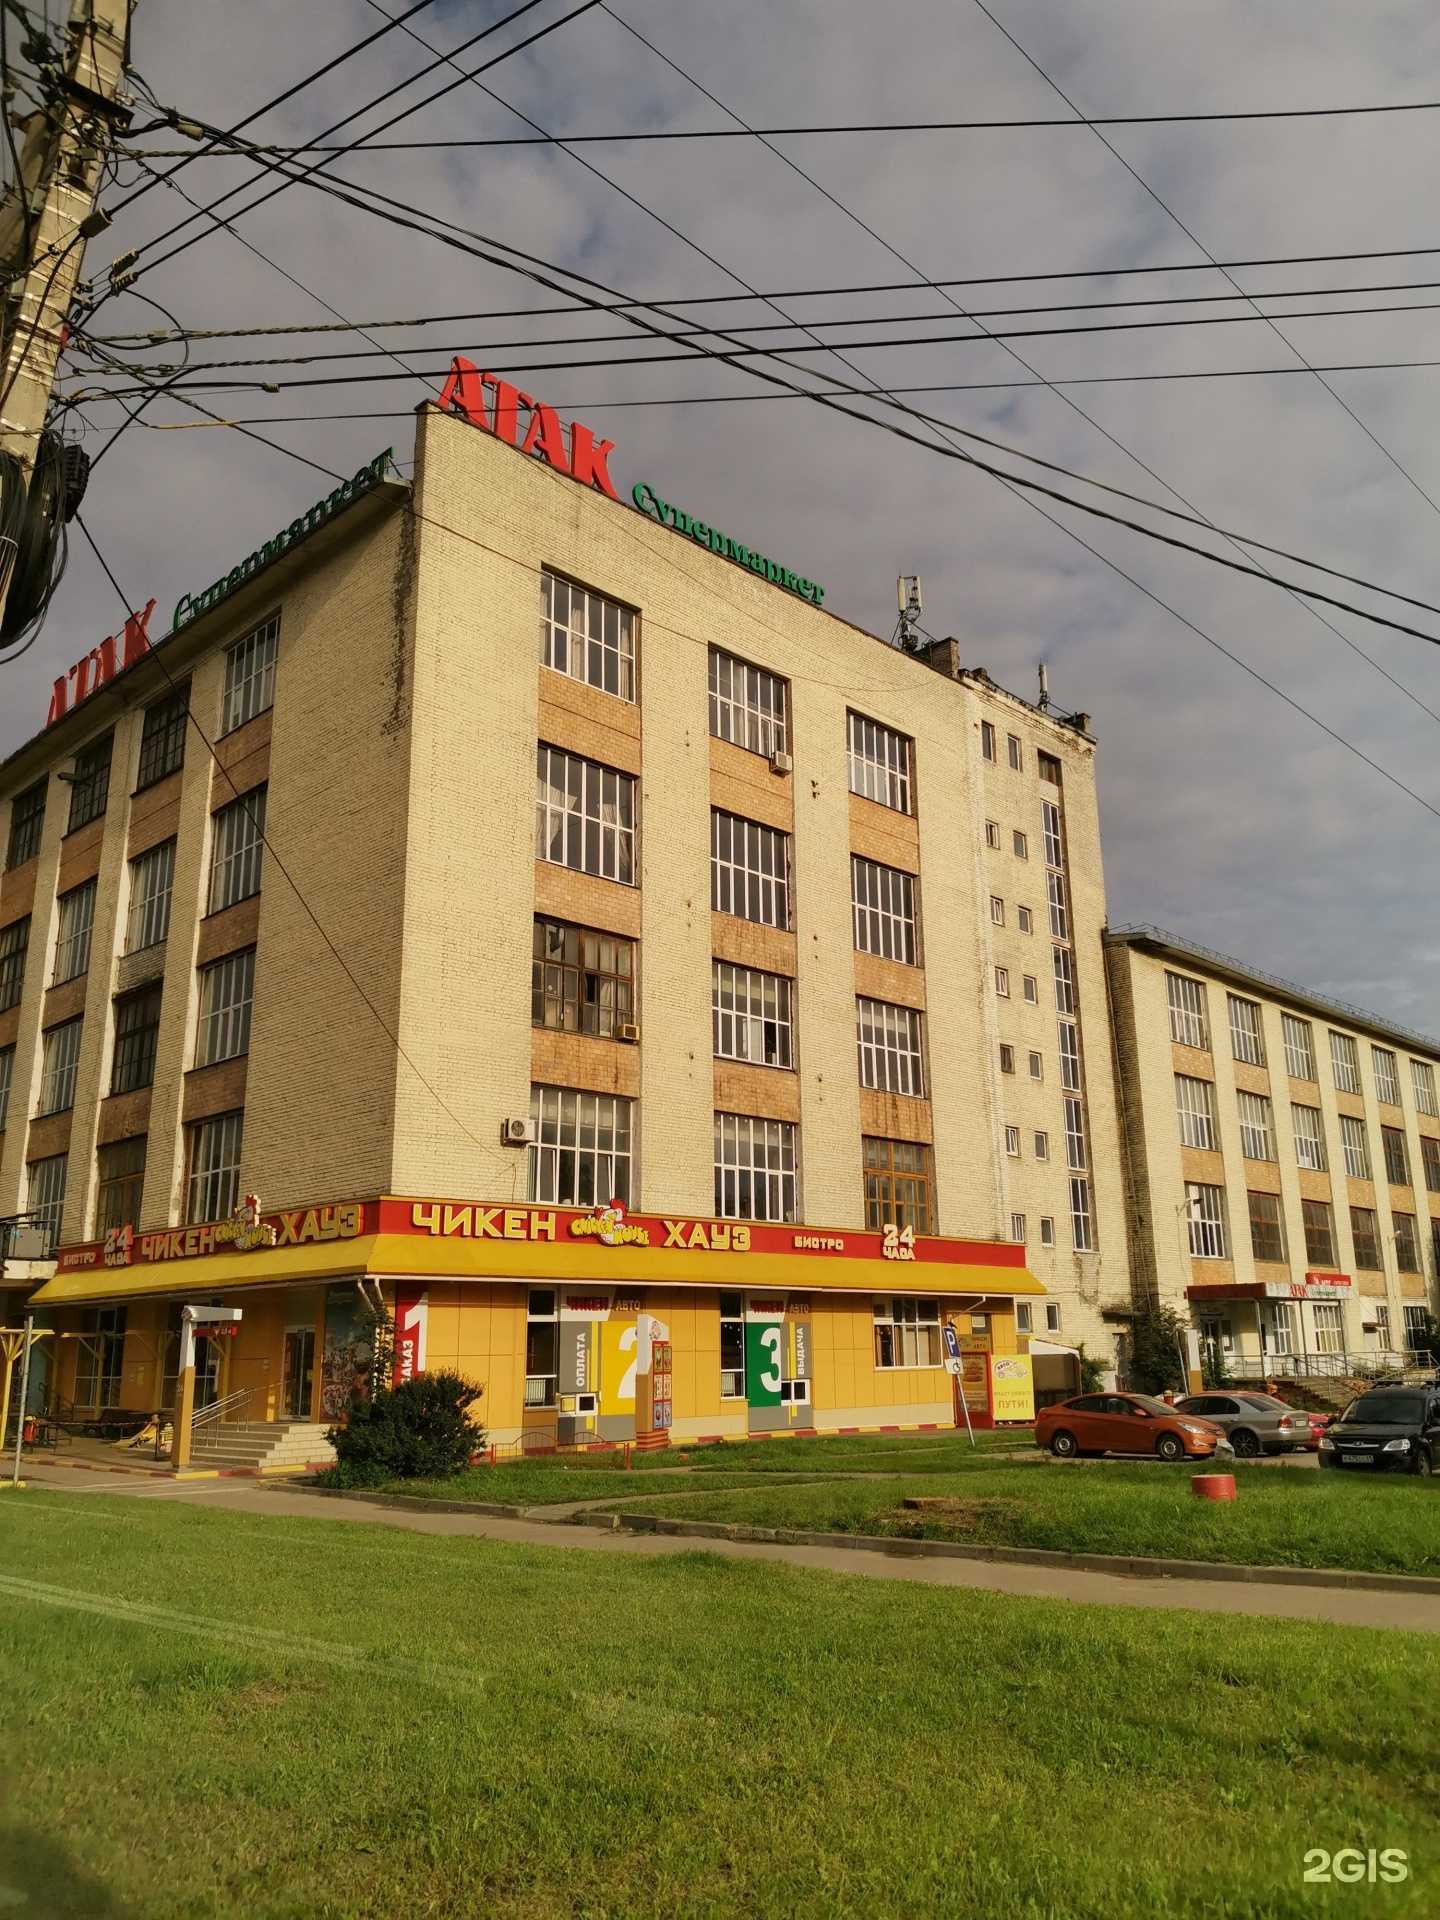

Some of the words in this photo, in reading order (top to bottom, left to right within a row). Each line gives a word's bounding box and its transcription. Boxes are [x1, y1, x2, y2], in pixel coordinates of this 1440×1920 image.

[438, 356, 619, 500] АТАК
[632, 482, 825, 604] Супермаркет
[104, 1224, 133, 1253] 24
[279, 1204, 364, 1245] ХАУЗ
[412, 1203, 556, 1241] ЧИКЕН
[663, 1221, 751, 1251] ХАУЗ
[883, 1223, 916, 1249] 24
[142, 1227, 215, 1260] ЧИКЕН
[794, 1235, 844, 1251] БИСТРО
[882, 1246, 916, 1260] ЧАСА
[405, 1291, 429, 1372] 1
[946, 1331, 957, 1354] P
[401, 1340, 414, 1382] АКАЗ
[576, 1333, 586, 1387] ОПЛАТА
[760, 1327, 782, 1393] 3
[796, 1328, 805, 1375] ВЫДАЧА
[998, 1400, 1028, 1409] ПУТИ!
